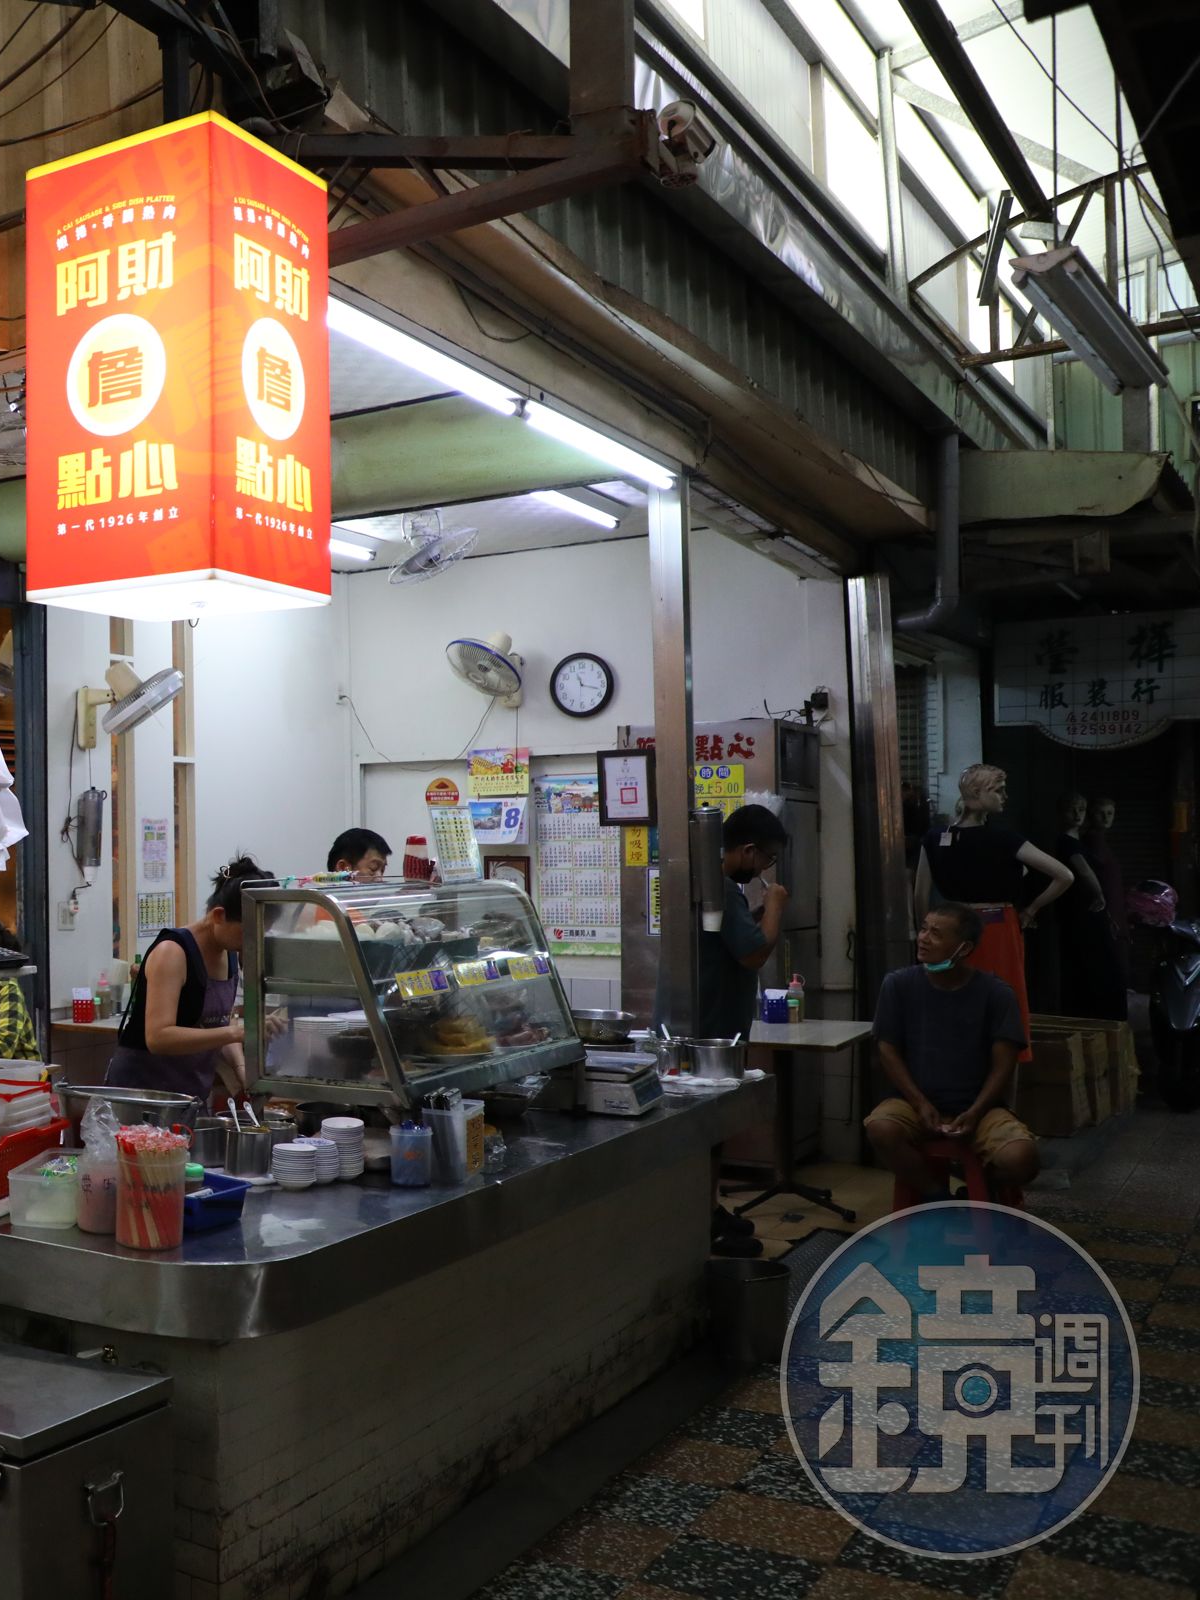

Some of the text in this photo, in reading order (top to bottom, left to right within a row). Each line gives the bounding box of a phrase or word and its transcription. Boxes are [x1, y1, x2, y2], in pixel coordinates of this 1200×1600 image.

[56, 231, 176, 316] 阿財
[233, 232, 310, 322] 阿財
[57, 439, 179, 511] 點心
[235, 436, 313, 513] 點心
[504, 808, 520, 829] 8
